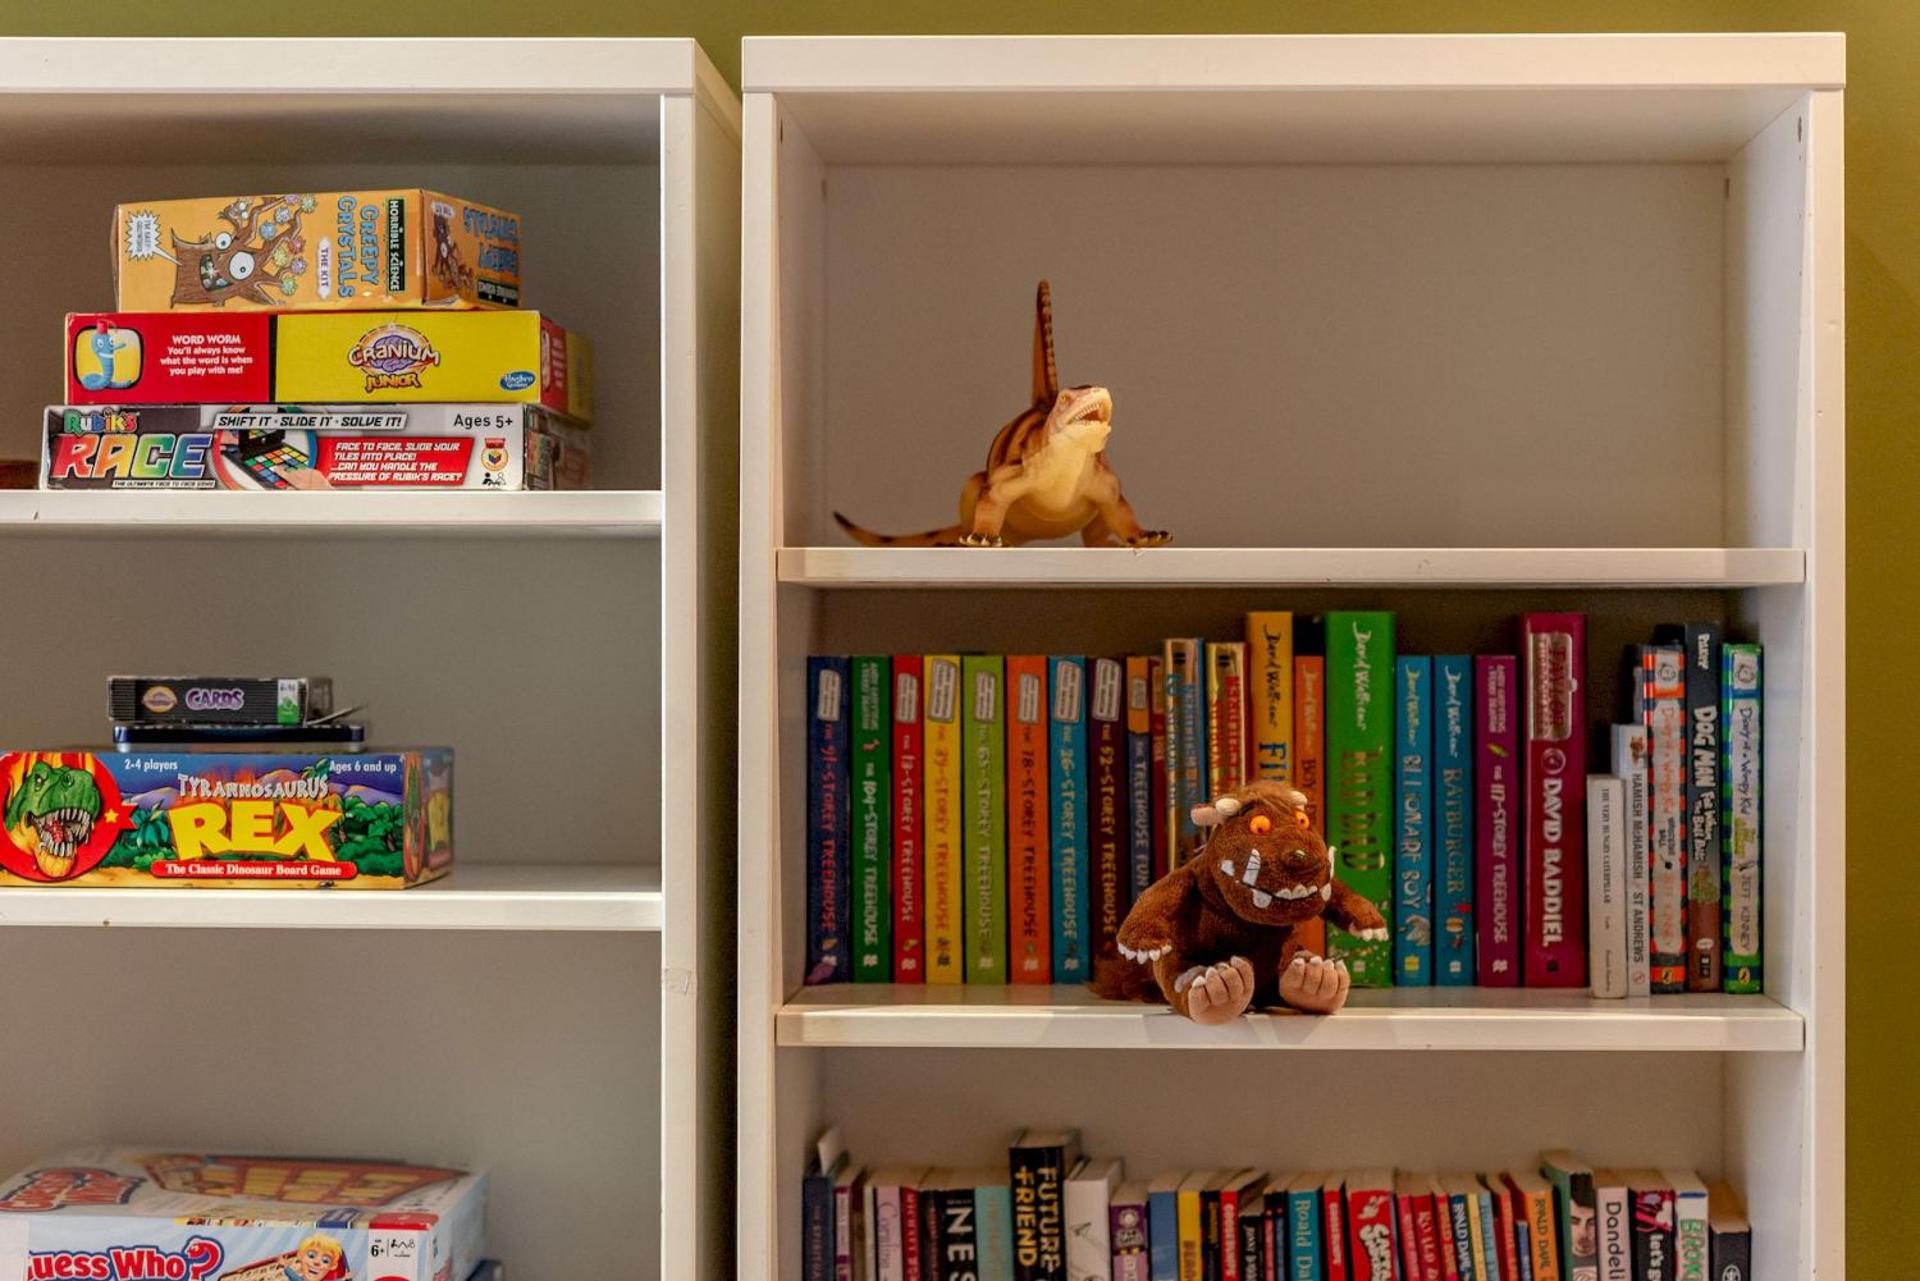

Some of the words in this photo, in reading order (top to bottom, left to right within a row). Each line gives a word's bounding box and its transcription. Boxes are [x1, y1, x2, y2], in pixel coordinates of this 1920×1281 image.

[389, 200, 400, 246] HORRIBLE
[319, 247, 329, 267] THE
[336, 196, 357, 298] CRYSTALS
[359, 205, 378, 286] CREEPY
[319, 269, 329, 287] KIT
[389, 249, 400, 291] SCIENCE
[160, 355, 181, 365] what
[182, 355, 197, 365] the
[198, 355, 220, 365] word
[221, 355, 229, 364] is
[230, 355, 253, 365] when
[167, 345, 192, 355] You'll
[193, 346, 221, 356] always
[222, 345, 246, 355] know
[172, 335, 204, 344] WORD
[206, 335, 241, 344] WORM
[169, 366, 186, 377] you
[187, 365, 206, 377] play
[207, 365, 226, 375] with
[227, 365, 244, 375] me!
[365, 373, 422, 393] JUNIOR
[218, 416, 256, 427] SHIFT
[258, 416, 272, 427] IT
[280, 416, 318, 427] SLIDE
[319, 416, 333, 427] IT
[341, 416, 381, 427] SOLVE
[384, 416, 401, 427] IT!
[453, 414, 491, 429] Ages
[496, 415, 513, 428] 5+
[50, 434, 213, 478] RACE
[334, 452, 359, 461] TILES
[360, 452, 383, 461] INTO
[336, 442, 361, 452] FACE
[362, 442, 376, 452] TO
[406, 442, 431, 452] SLIDE
[433, 442, 460, 452] YOUR
[359, 462, 379, 471] YOU
[380, 462, 418, 471] HANDLE
[419, 462, 438, 471] THE
[328, 472, 376, 481] PRESSURE
[378, 472, 391, 481] OF
[431, 472, 463, 481] RACE?
[1264, 624, 1282, 669] David
[1353, 622, 1372, 669] David
[1697, 633, 1710, 670] PILKEY
[187, 688, 244, 710] CARDS
[1267, 669, 1282, 728] Walliams
[1354, 670, 1370, 731] Walliams
[1405, 665, 1419, 699] David
[1444, 665, 1461, 706] David
[1661, 707, 1674, 739] Diary
[1693, 706, 1716, 746] DOG
[1738, 707, 1752, 739] Diary
[124, 759, 141, 770] 2-4
[143, 759, 178, 772] players
[329, 760, 352, 773] Ages
[354, 761, 361, 771] 6
[363, 760, 382, 772] and
[385, 763, 397, 774] up
[1301, 758, 1317, 788] BOY
[1660, 760, 1674, 796] Wimpy
[1693, 748, 1716, 787] MAN
[1738, 759, 1752, 795] Wimpy
[177, 773, 329, 800] TYRANNOSAURUS
[820, 746, 837, 833] 91-STOREY
[899, 754, 915, 833] 13-STOREY
[933, 750, 949, 833] 39-STOREY
[976, 746, 990, 838] 65-STOREY
[1022, 750, 1036, 838] 78-STOREY
[1060, 748, 1075, 839] 26-STOREY
[1098, 746, 1114, 835] 52-STOREY
[1134, 760, 1148, 848] TREEHOUSE
[1601, 787, 1610, 802] THE
[1632, 773, 1644, 817] HAMISH
[1663, 797, 1675, 815] Kid
[1741, 797, 1752, 815] Kid
[862, 781, 877, 861] 104-STOREY
[1402, 755, 1422, 862] BILLIONAIRE
[1491, 783, 1507, 858] 117-STOREY
[1542, 778, 1562, 843] DAVID
[1601, 804, 1611, 823] VERY
[168, 800, 343, 862] REX
[1443, 767, 1465, 894] RATBURGER
[1602, 824, 1611, 854] HUNGRY
[1632, 820, 1644, 879] McHAMISH
[1658, 829, 1667, 848] BALL
[165, 863, 185, 875] The
[186, 863, 224, 875] Classic
[226, 863, 273, 875] Dinosaur
[275, 863, 309, 875] Board
[311, 863, 341, 876] Game
[821, 838, 836, 933] TREEHOUSE
[901, 838, 915, 923] TREEHOUSE
[935, 842, 949, 929] TREEHOUSE
[1102, 842, 1116, 934] TREEHOUSE
[1136, 853, 1149, 887] FUN
[1402, 870, 1421, 910] BOY
[1603, 855, 1612, 904] CATERPILLAR
[1741, 873, 1752, 899] JEFF
[862, 866, 877, 946] TREEHOUSE
[978, 845, 992, 937] TREEHOUSE
[1024, 846, 1037, 937] TREEHOUSE
[1062, 846, 1077, 940] TREEHOUSE
[1492, 864, 1508, 943] TREEHOUSE
[1542, 848, 1562, 947] BADDIEL
[1632, 892, 1643, 910] ST
[1632, 912, 1643, 963] ANDREWS
[1740, 906, 1751, 949] KINNEY
[1015, 1164, 1038, 1267] FRIEND
[1037, 1166, 1060, 1273] FUTURE
[1295, 1199, 1312, 1248] Roald
[1453, 1202, 1469, 1239] ROALD
[1535, 1198, 1548, 1235] ROALD
[1417, 1211, 1435, 1262] ROALD
[1456, 1239, 1471, 1268] DAHL
[1537, 1239, 1551, 1270] DAHL
[1650, 1234, 1664, 1267] let's
[112, 1237, 220, 1281] Who?
